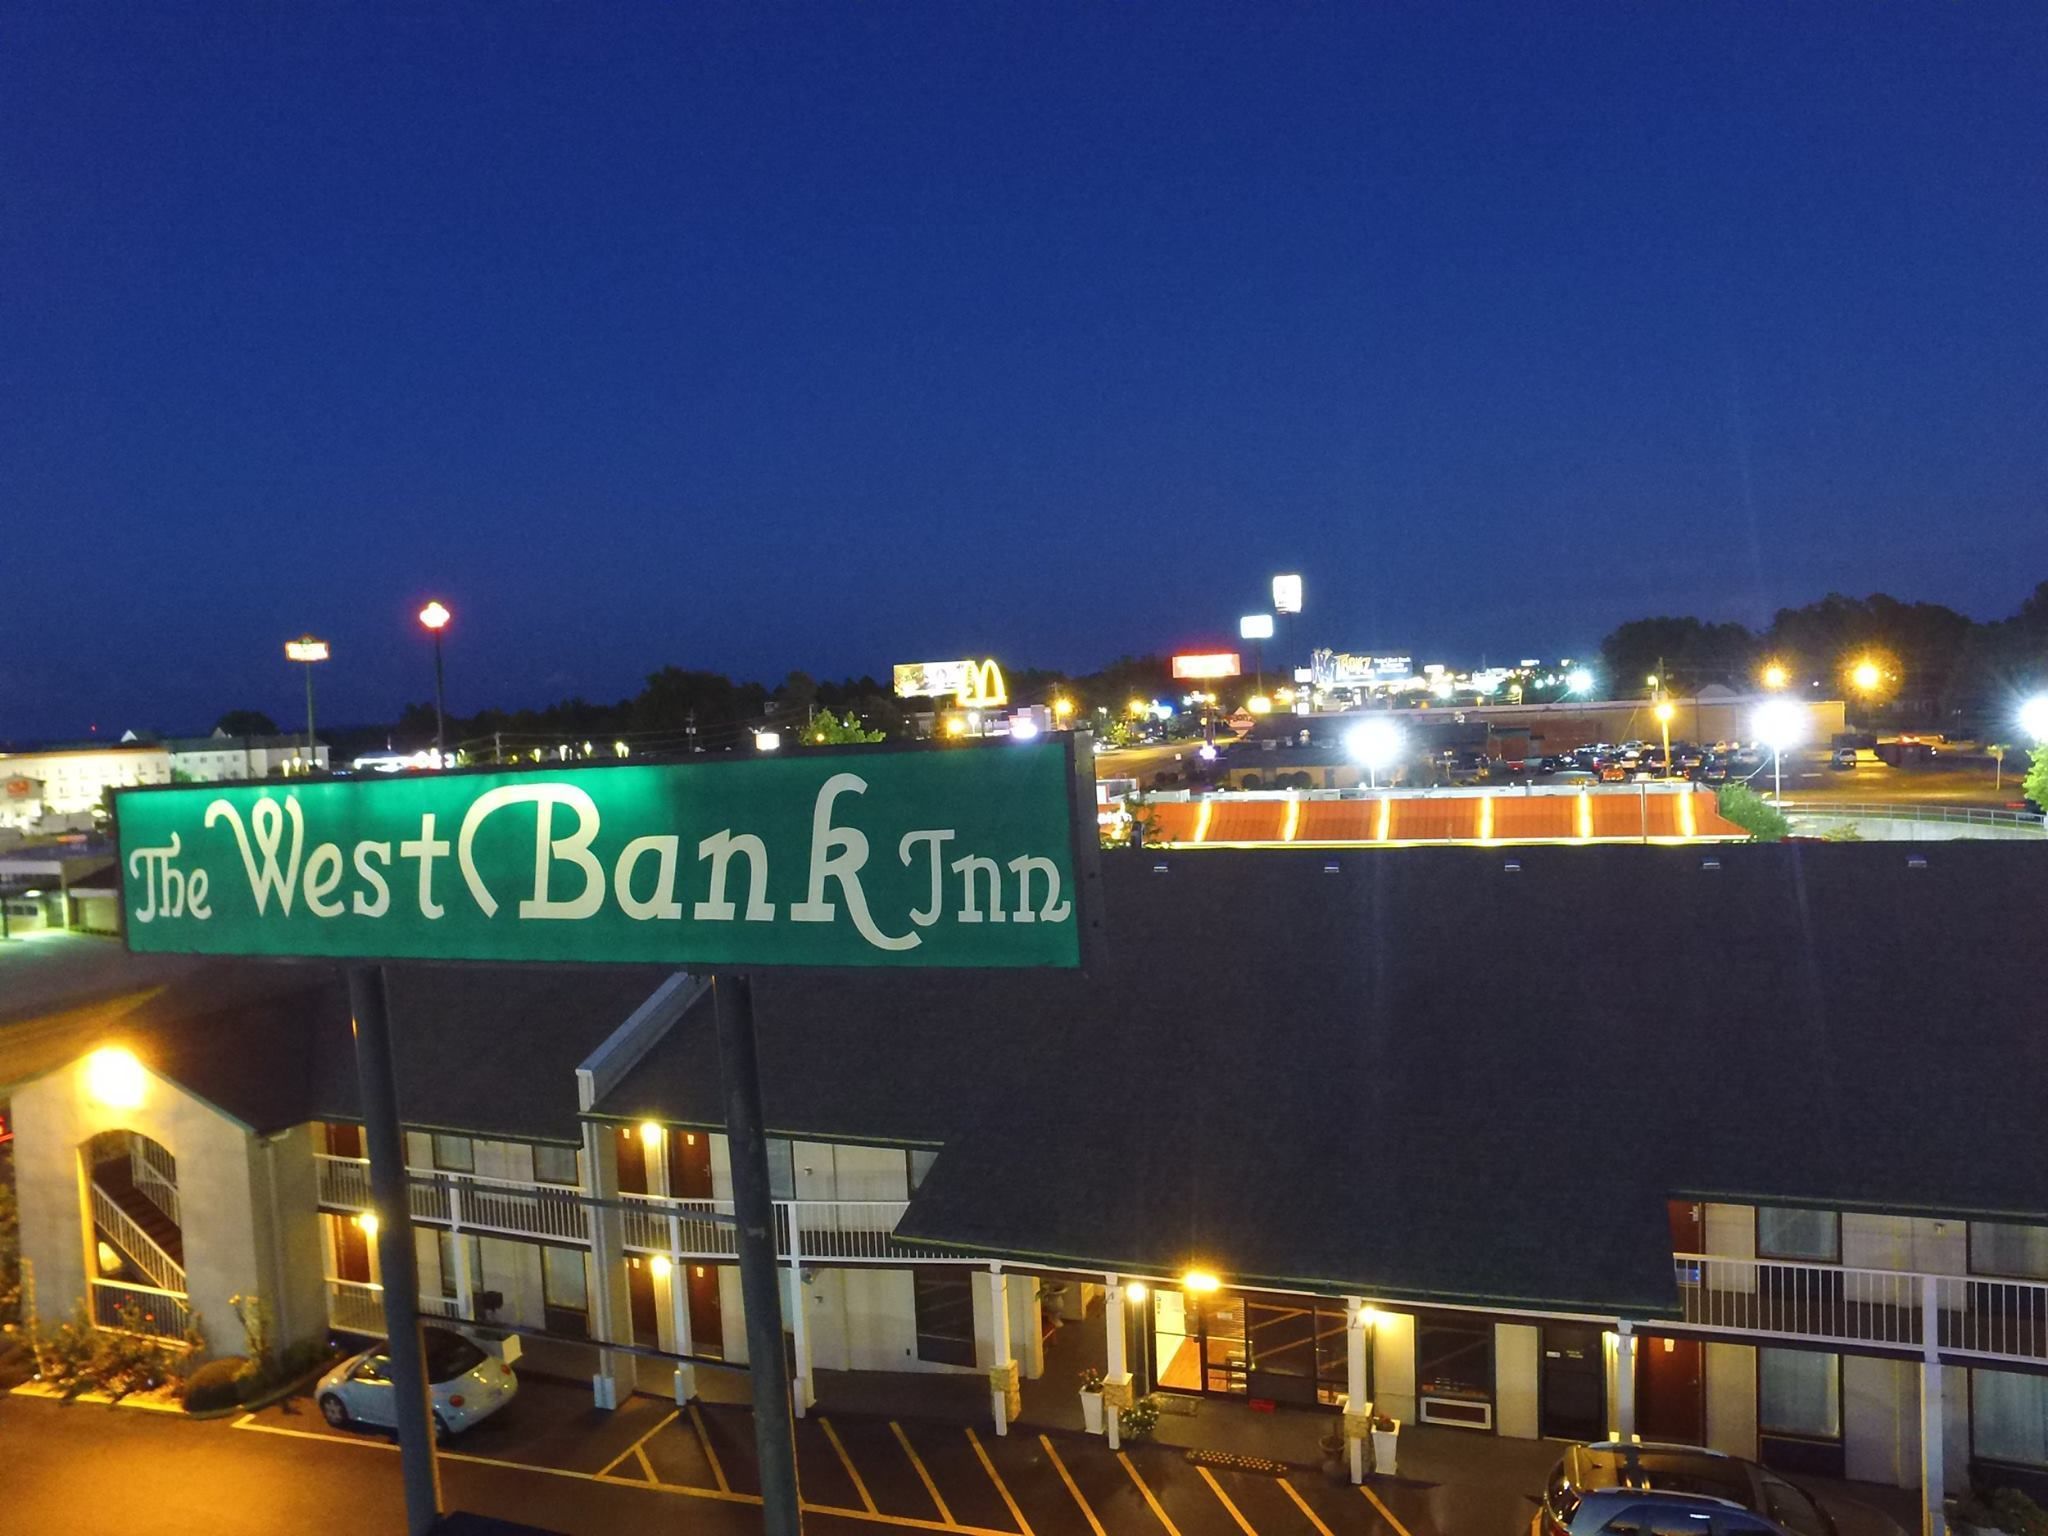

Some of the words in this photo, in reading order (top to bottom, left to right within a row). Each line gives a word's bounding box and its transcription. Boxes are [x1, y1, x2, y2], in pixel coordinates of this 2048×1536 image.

[130, 831, 212, 923] The
[205, 794, 450, 920] West
[458, 772, 922, 951] Bank
[899, 829, 1071, 926] Inn
